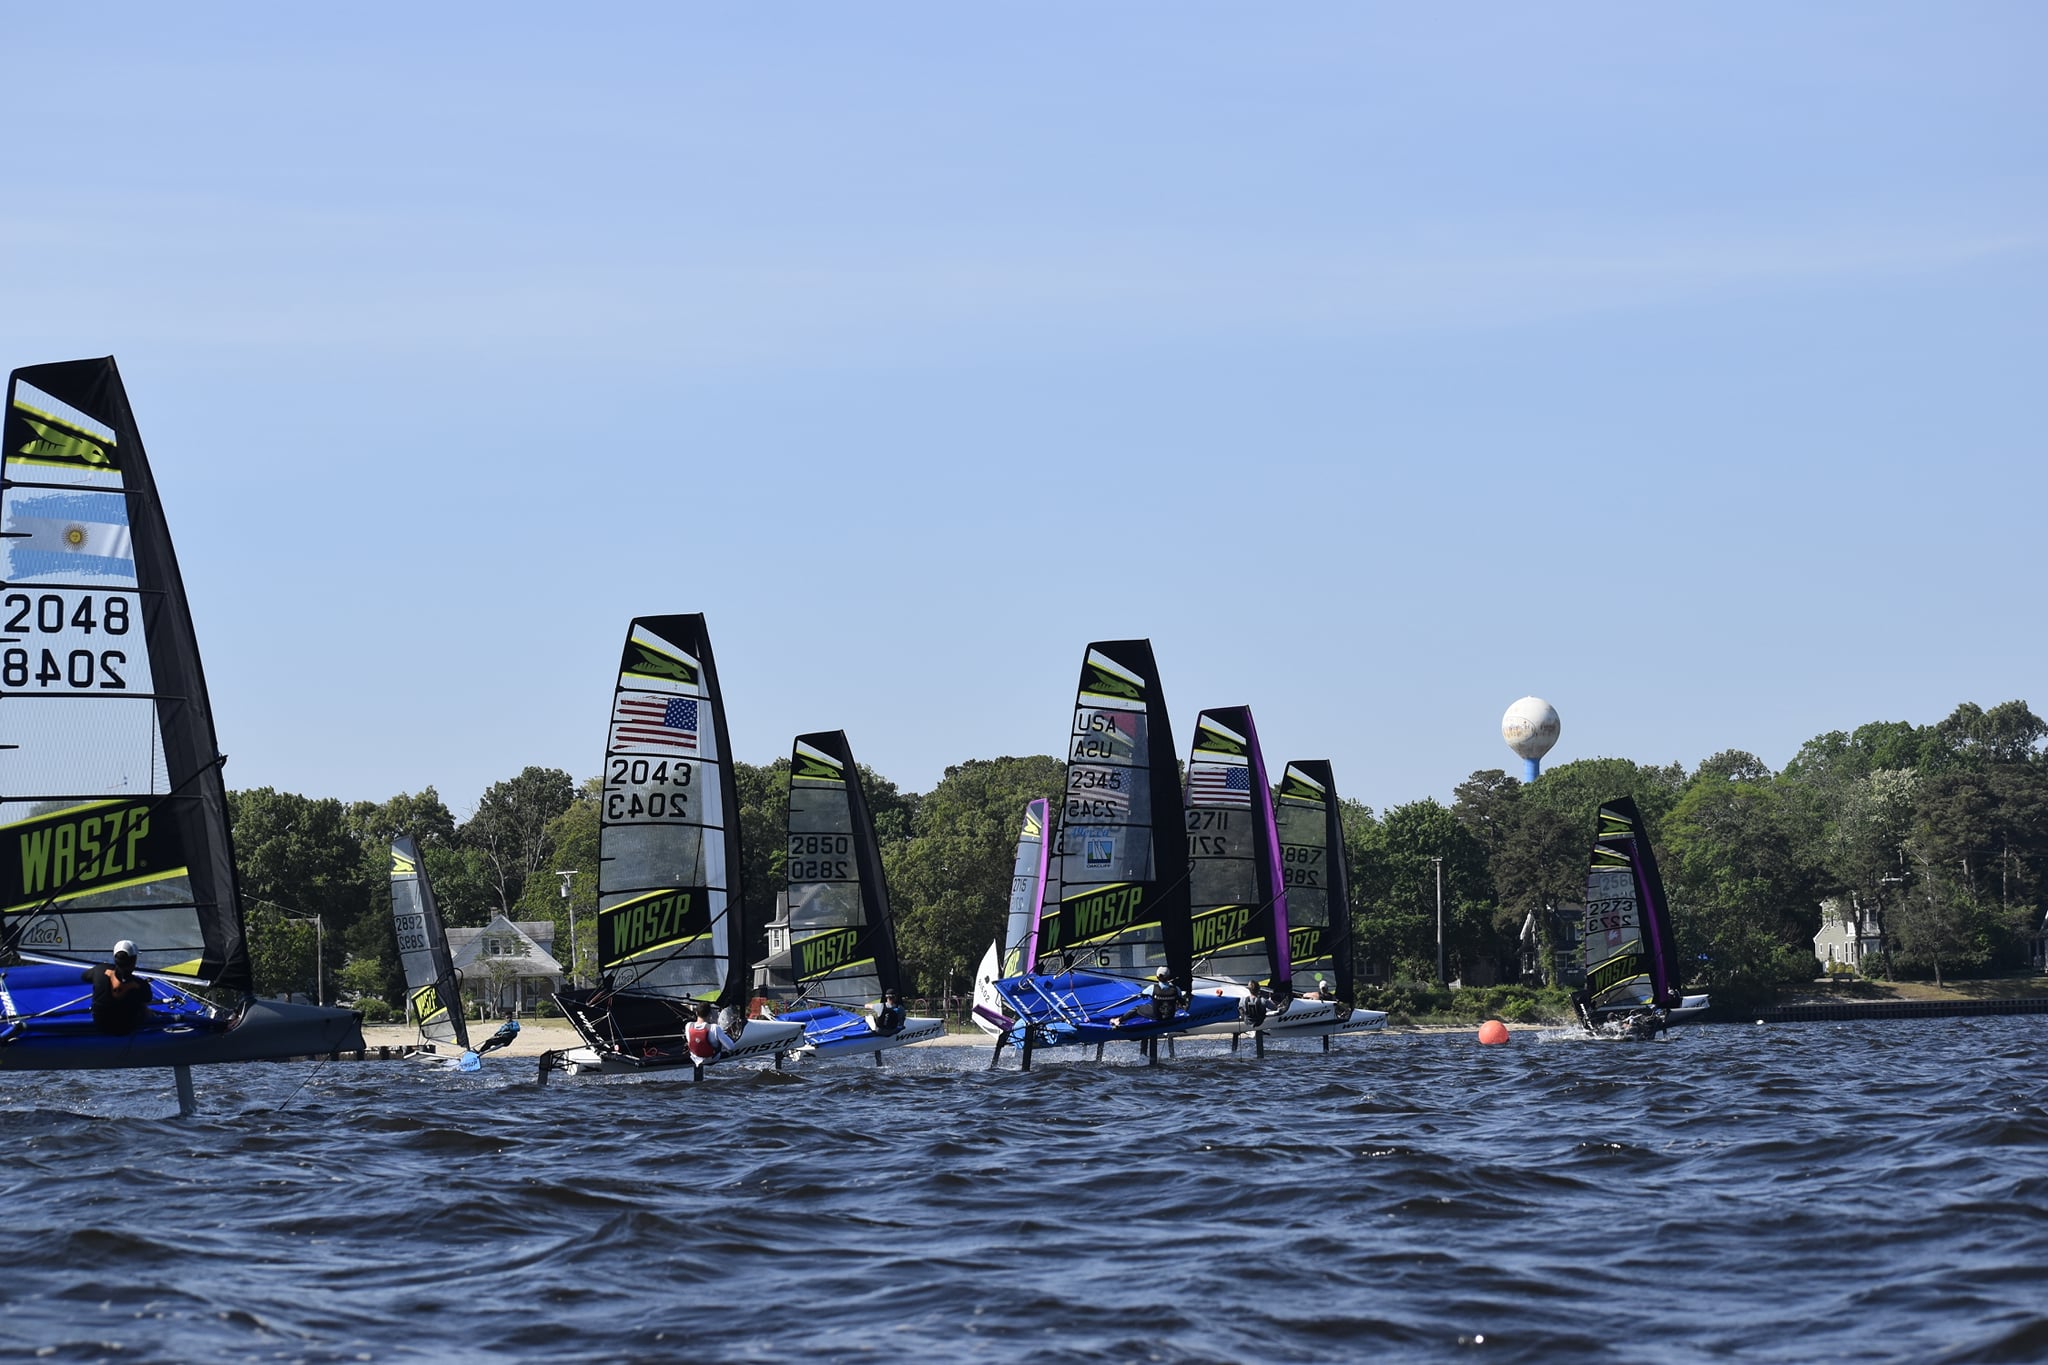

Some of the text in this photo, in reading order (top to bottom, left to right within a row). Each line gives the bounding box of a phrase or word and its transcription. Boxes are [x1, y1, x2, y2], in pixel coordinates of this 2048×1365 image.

[4, 594, 129, 635] 2048
[1078, 713, 1116, 733] USA
[611, 759, 692, 787] 2043
[1071, 771, 1121, 789] 2345
[1188, 811, 1228, 830] 2711
[20, 806, 149, 895] WASZP
[791, 836, 849, 855] 2850
[1074, 886, 1142, 937] WASZP
[1589, 901, 1633, 916] 2273
[396, 916, 422, 931] 2892
[613, 893, 691, 955] WASZP
[1192, 908, 1249, 951] WASZP
[803, 930, 858, 974] WASZP
[1290, 930, 1321, 959] SZP
[1594, 956, 1637, 992] WASZP
[1278, 1009, 1331, 1023] WASZP
[1343, 1018, 1384, 1029] WASZP
[896, 1027, 940, 1041] WASZP
